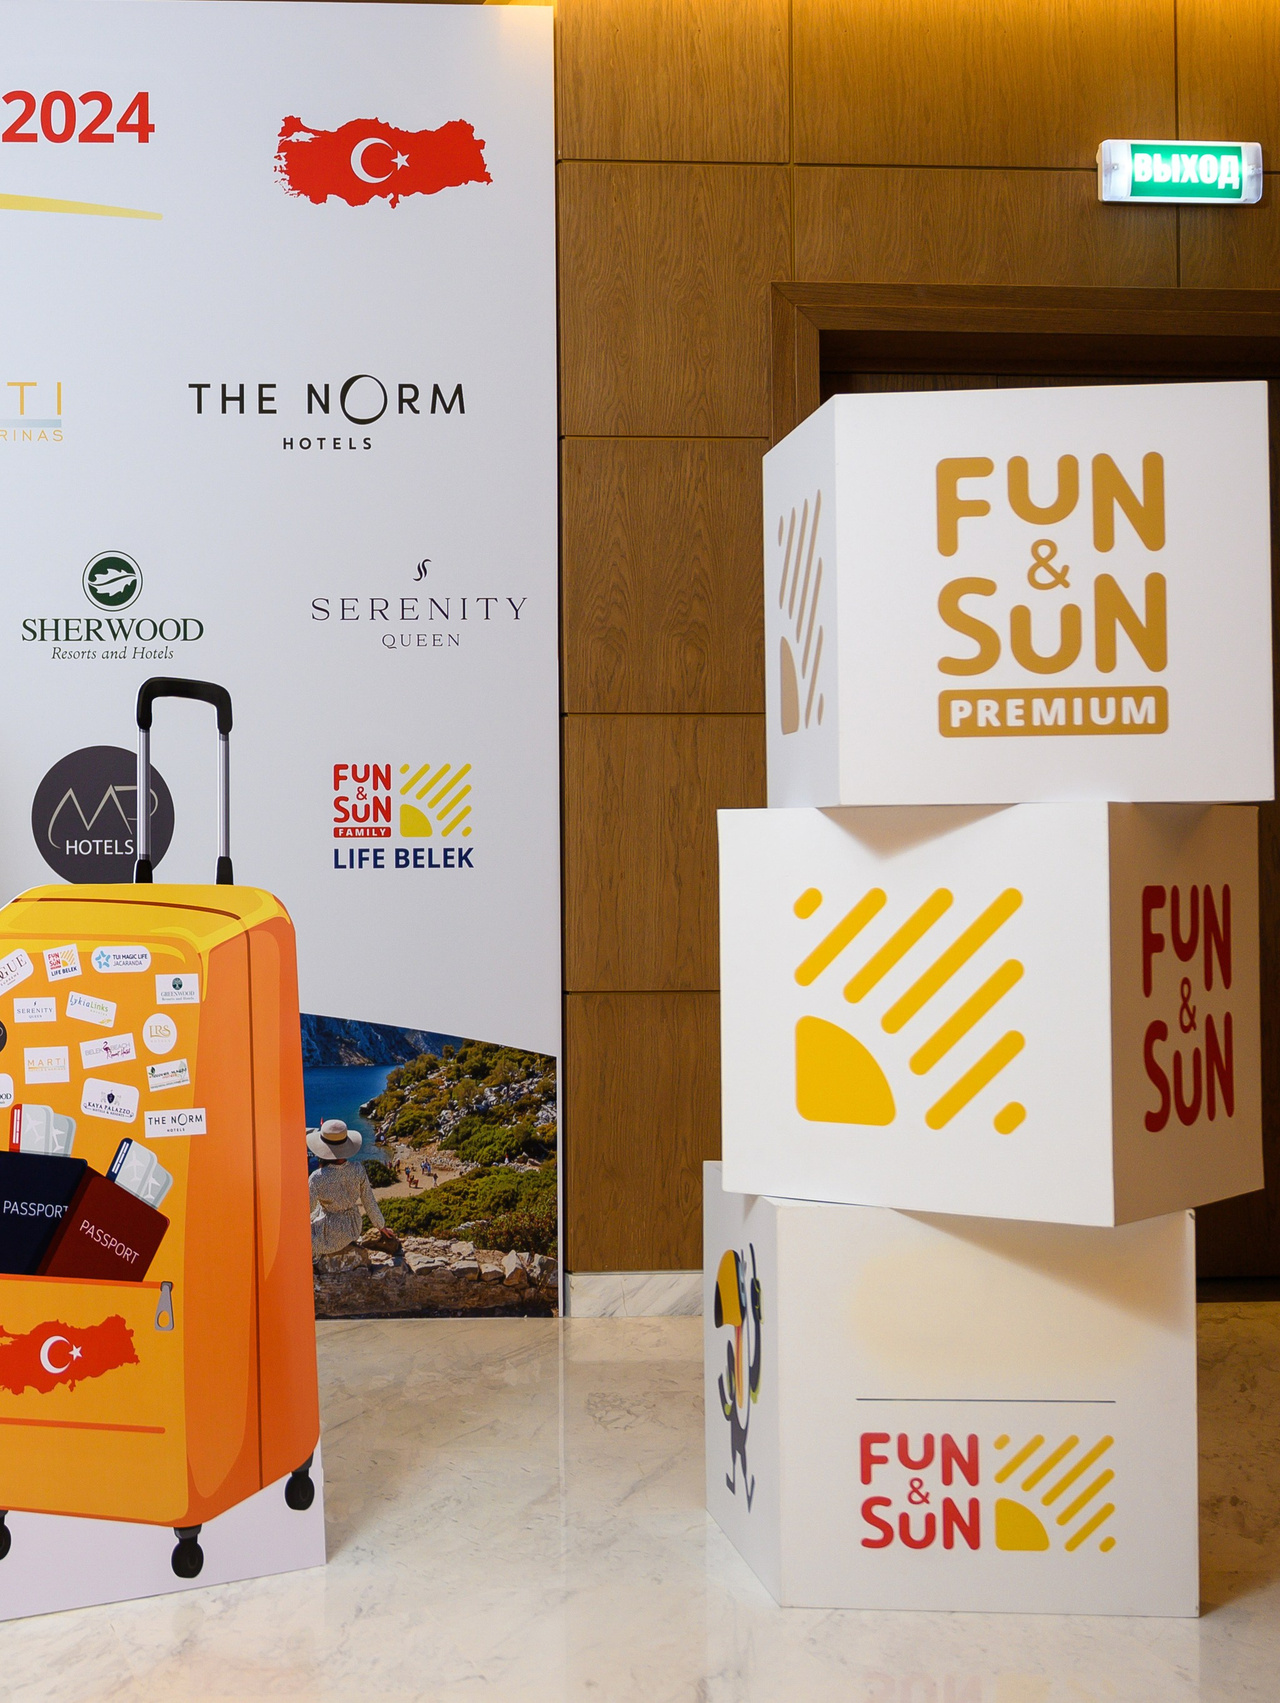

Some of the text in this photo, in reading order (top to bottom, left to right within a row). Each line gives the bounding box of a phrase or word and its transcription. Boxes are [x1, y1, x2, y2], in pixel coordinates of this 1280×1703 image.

[2, 90, 155, 144] 2024
[1134, 152, 1240, 190] ВЫХОД
[188, 374, 466, 425] THE NORM
[282, 438, 372, 451] HOTELS
[936, 452, 1166, 557] FUN
[1027, 538, 1071, 590] &
[312, 598, 528, 620] SERENITY
[21, 618, 204, 642] SHERWOOD
[938, 572, 1168, 677] SUN
[51, 646, 174, 660] Resorts and Hotels
[382, 634, 460, 650] QUEEN
[950, 696, 1156, 728] PREMIUM
[334, 764, 392, 791] FUN
[356, 786, 368, 800] &
[334, 796, 392, 823] SUN
[338, 828, 386, 836] FAMILY
[66, 840, 134, 856] HOTELS
[334, 848, 474, 868] LIFE BELEK
[1142, 884, 1232, 998] FUN
[1179, 976, 1196, 1034] &
[28, 1058, 66, 1067] MARTI
[1144, 1011, 1234, 1132] SUN
[148, 1113, 202, 1126] THE NORM
[80, 1220, 140, 1264] PASSPORT
[860, 1432, 979, 1486] FUN
[908, 1477, 930, 1505] &
[861, 1496, 980, 1550] SUN
